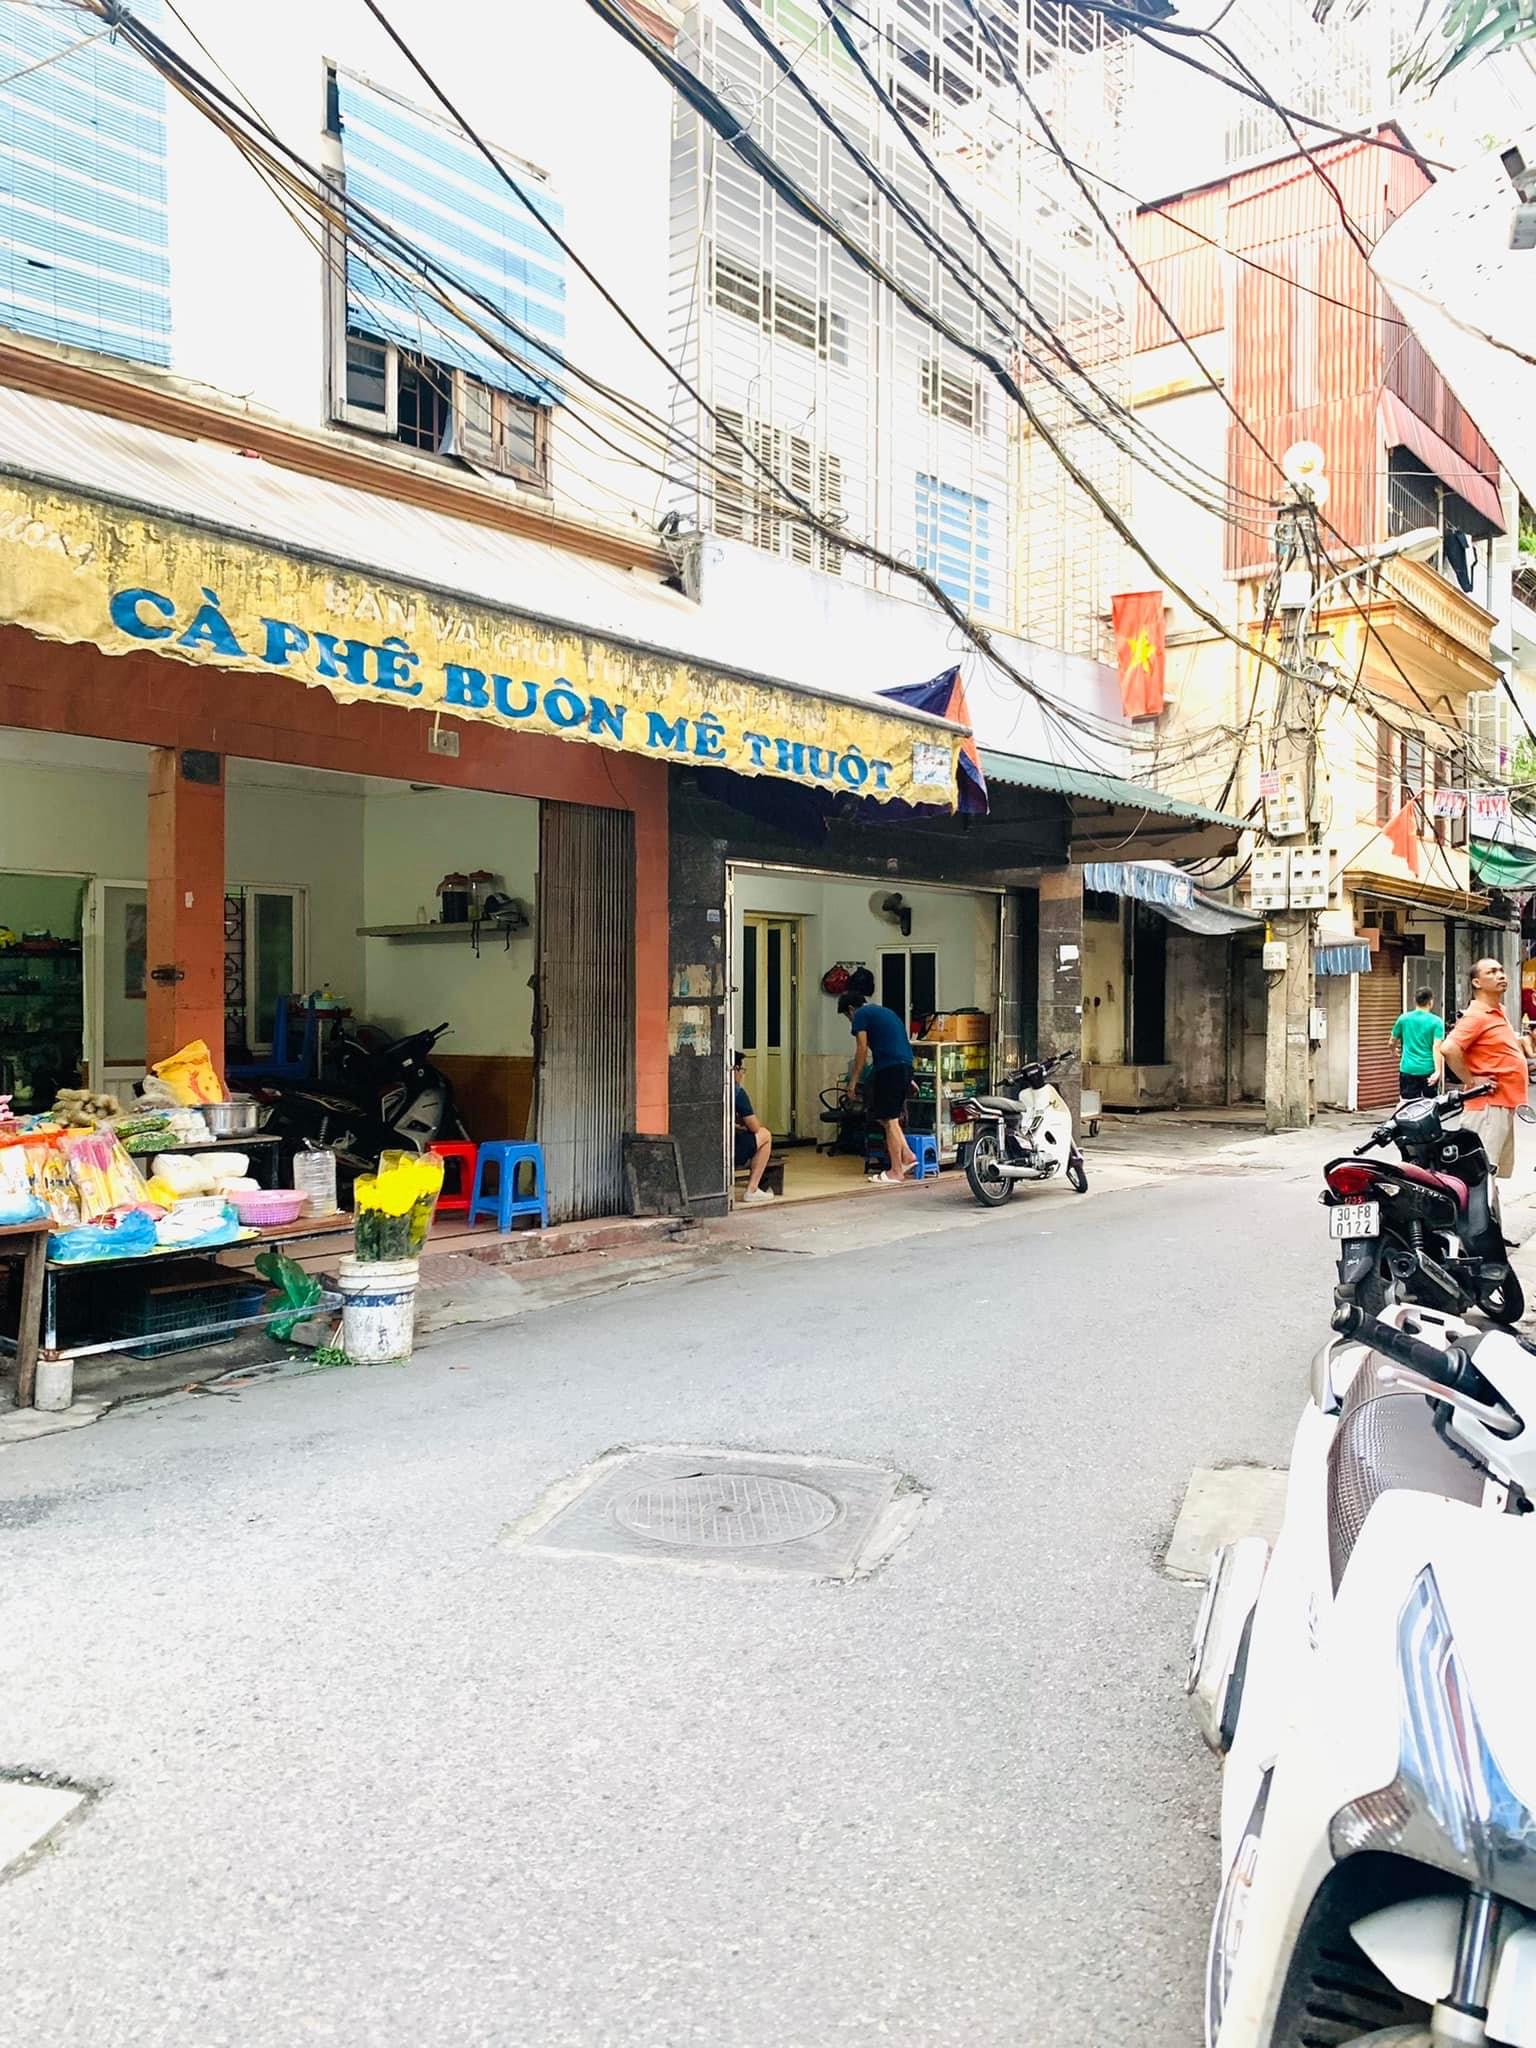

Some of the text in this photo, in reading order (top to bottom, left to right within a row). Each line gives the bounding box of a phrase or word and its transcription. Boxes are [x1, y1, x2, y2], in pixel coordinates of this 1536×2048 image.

[110, 587, 247, 656] CÀ
[260, 617, 423, 696] PHÊ
[443, 662, 627, 741] BUÔN
[645, 711, 726, 760] MÊ
[742, 730, 893, 790] THUỘT
